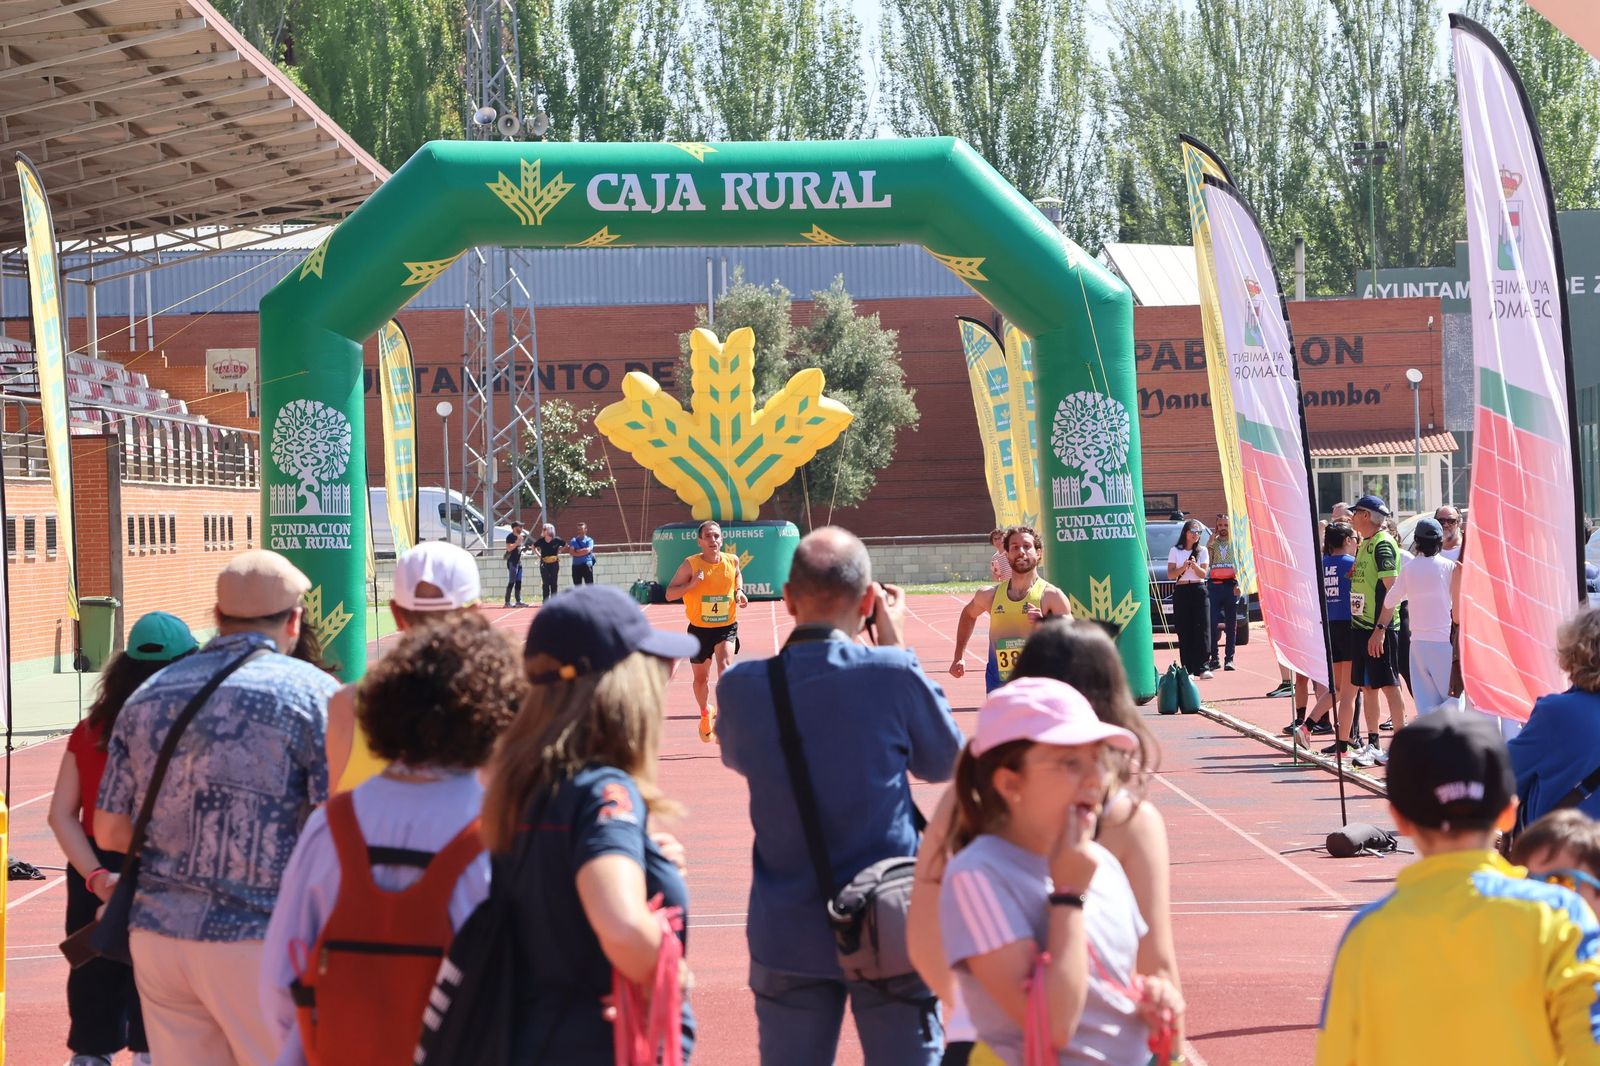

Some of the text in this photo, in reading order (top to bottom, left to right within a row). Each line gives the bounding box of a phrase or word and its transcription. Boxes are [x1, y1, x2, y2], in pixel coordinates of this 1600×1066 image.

[586, 170, 892, 214] CAJA RURAL
[1363, 281, 1472, 300] AYUNTAM
[1135, 336, 1364, 371] PABON
[1137, 386, 1211, 418] Manu
[1055, 512, 1135, 528] FUNDACION
[270, 523, 352, 536] FUNDACION
[681, 530, 697, 541] LEÓ
[721, 529, 764, 539] OURENSE
[1056, 526, 1137, 542] CAJA RURAL
[271, 537, 352, 550] CAJA RURAL
[1325, 566, 1338, 576] WE
[711, 603, 718, 614] 4
